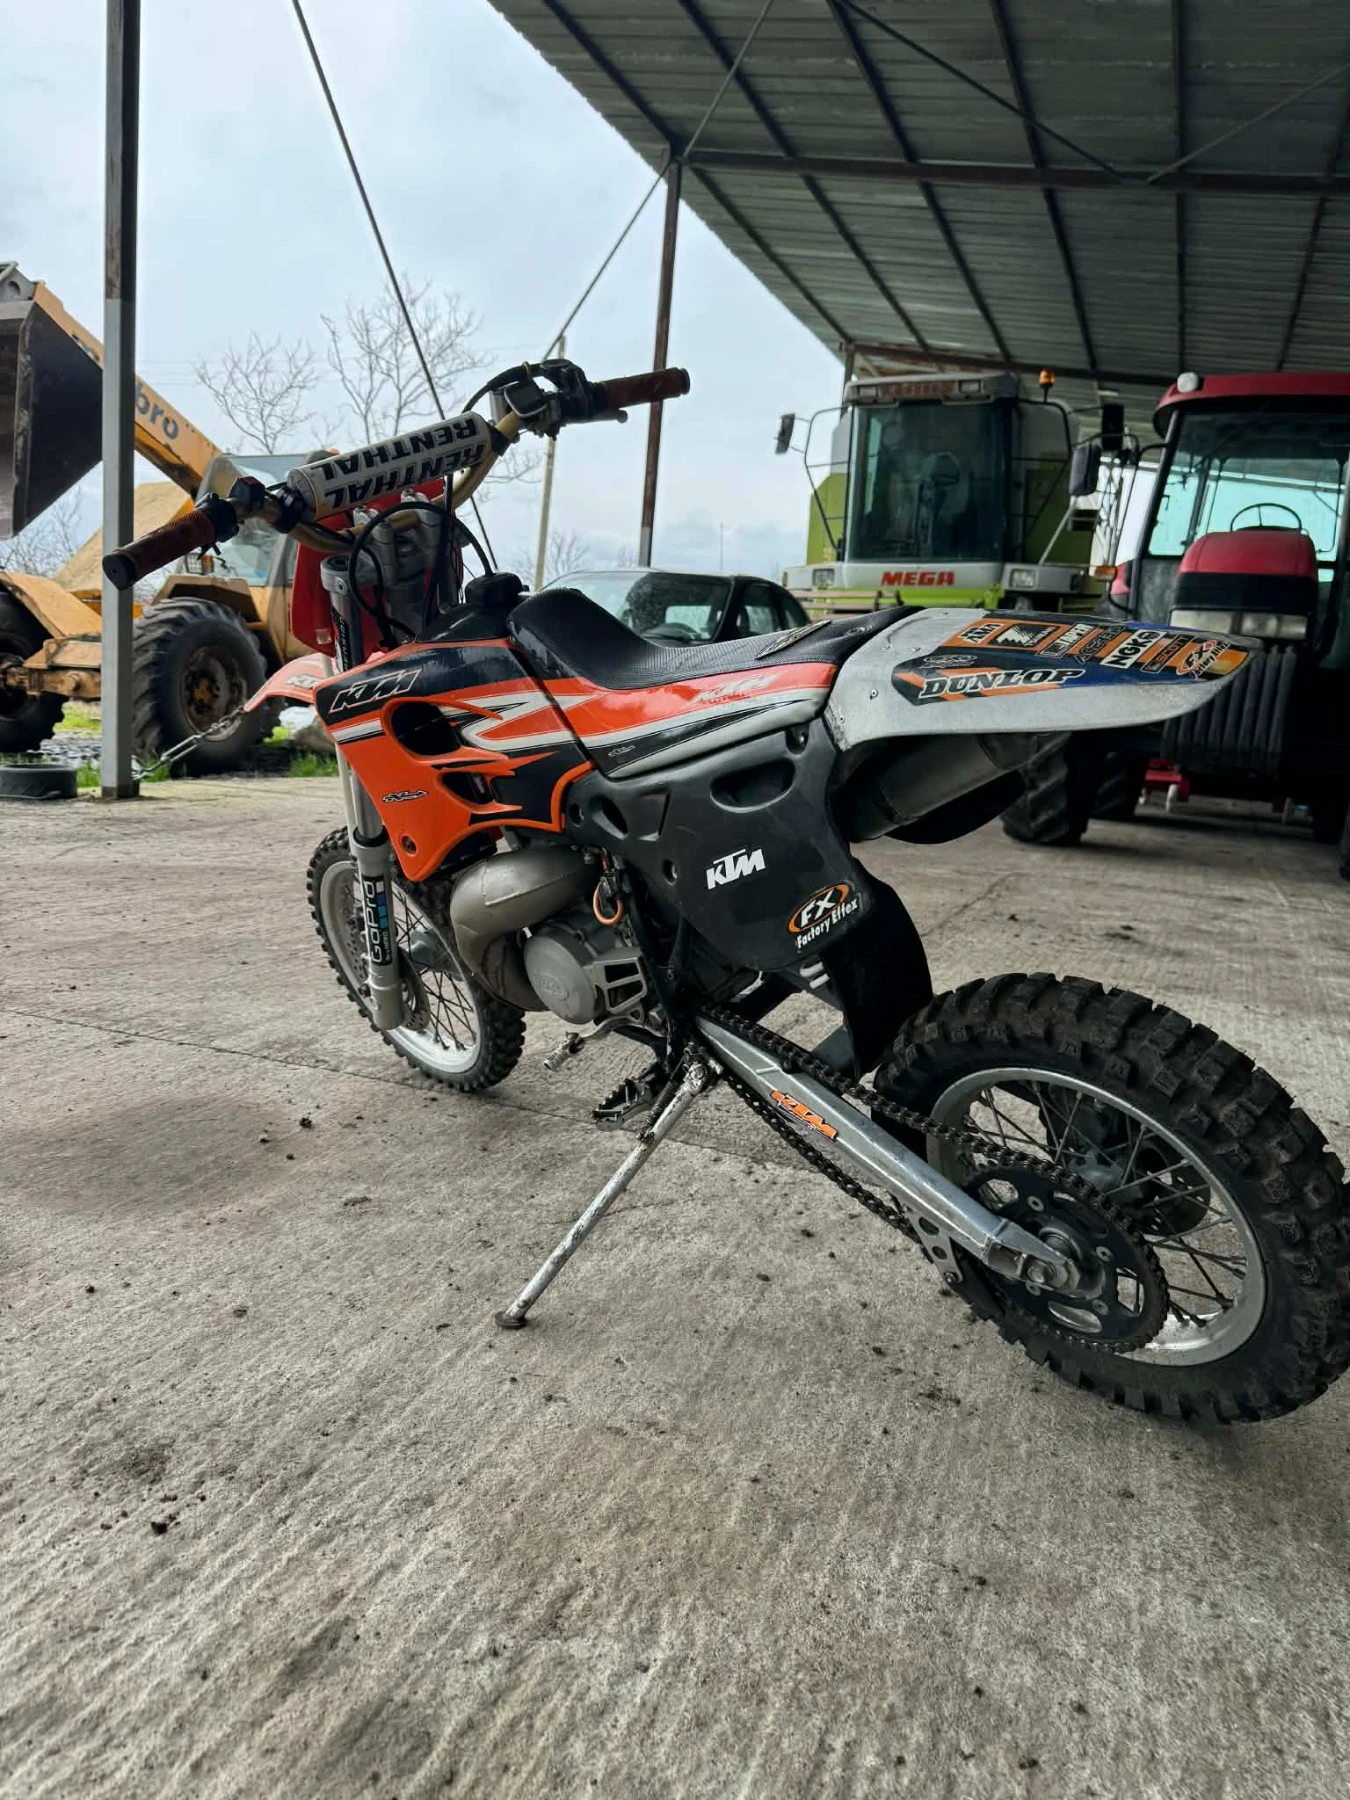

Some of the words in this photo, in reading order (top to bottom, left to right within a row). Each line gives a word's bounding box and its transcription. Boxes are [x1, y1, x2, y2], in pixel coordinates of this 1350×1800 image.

[311, 418, 477, 481] RENTHAL
[324, 442, 486, 509] RENTHAL
[881, 571, 954, 586] MEGA
[1107, 637, 1148, 667] NGK
[328, 669, 422, 714] KTM
[918, 668, 1086, 699] DUNLOP
[706, 849, 766, 890] KTM
[363, 881, 382, 963] GoPro
[797, 919, 831, 949] Factory
[831, 897, 858, 925] Effex
[800, 890, 836, 928] FX
